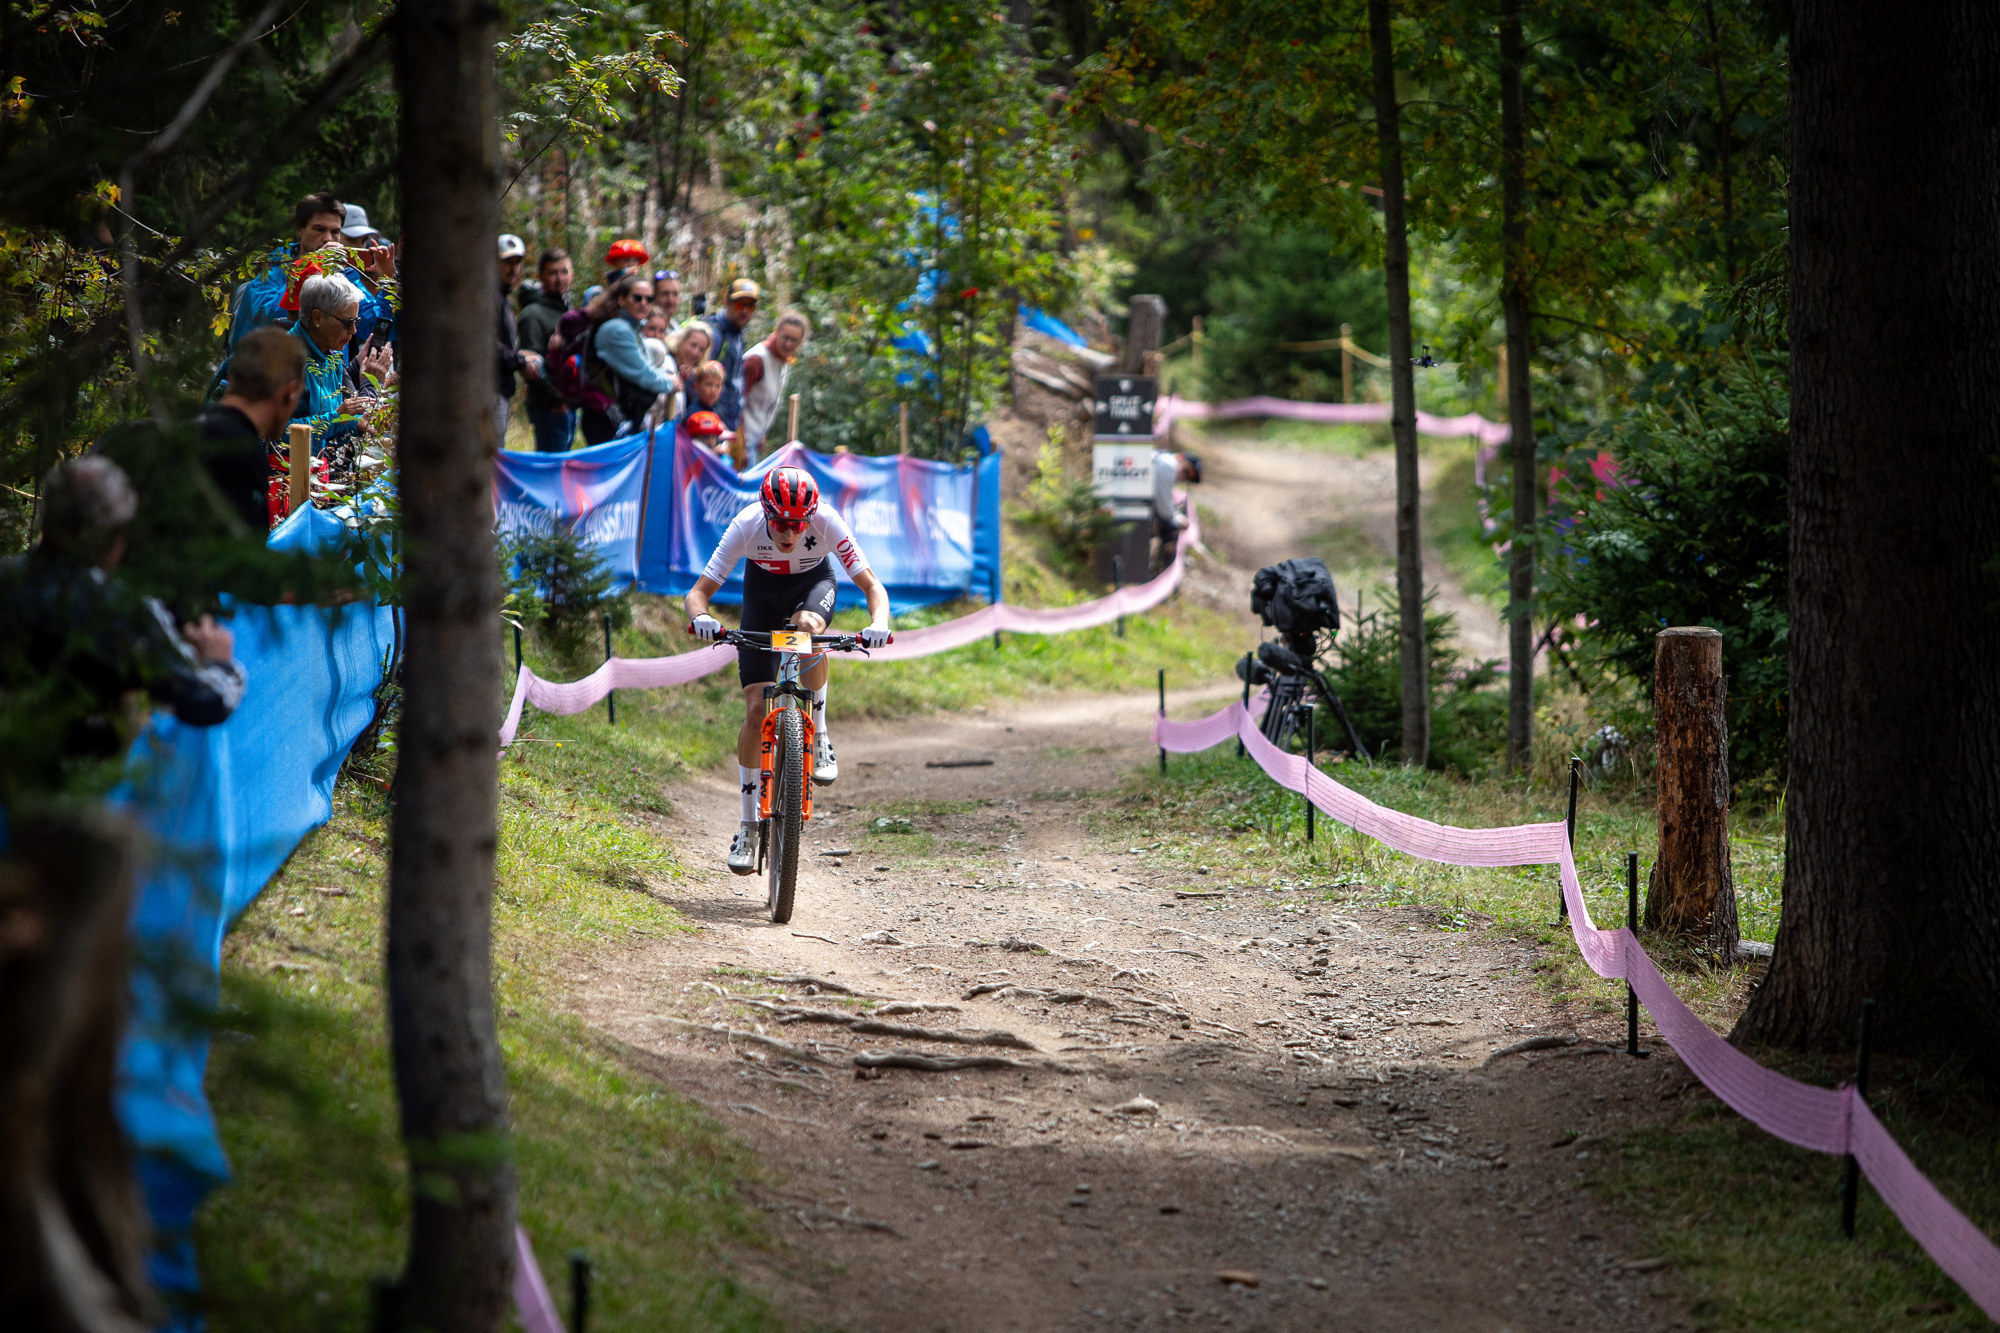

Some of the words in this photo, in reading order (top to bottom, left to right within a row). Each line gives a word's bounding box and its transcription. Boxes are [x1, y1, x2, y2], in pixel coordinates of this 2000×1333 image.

[1111, 407, 1141, 419] TIME
[837, 536, 860, 570] ÖKK
[785, 636, 798, 646] 2
